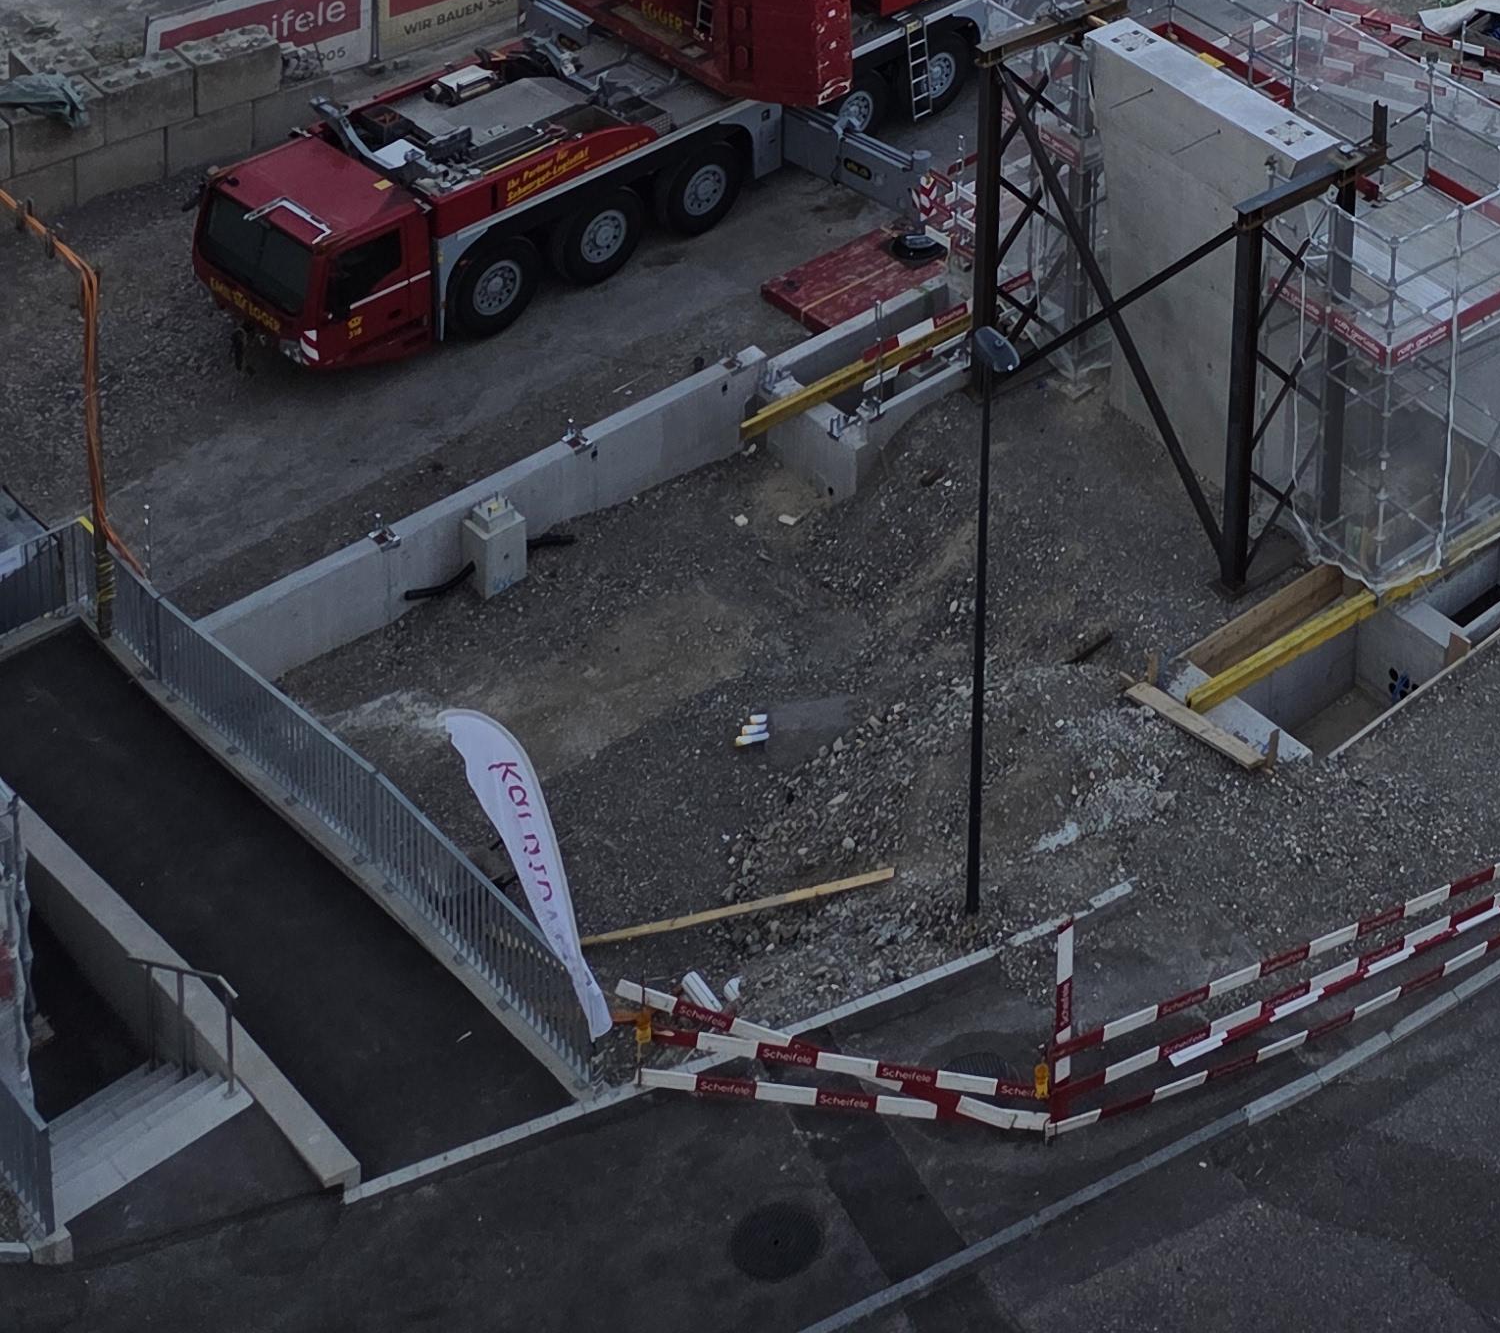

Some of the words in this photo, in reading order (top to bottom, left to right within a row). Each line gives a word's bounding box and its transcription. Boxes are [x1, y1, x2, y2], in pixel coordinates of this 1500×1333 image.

[271, 0, 346, 39] ifele
[404, 18, 432, 35] WIR
[437, 1, 483, 26] BAUEN
[641, 0, 683, 34] EGGER
[679, 1005, 728, 1029] Scheifele
[762, 1047, 812, 1066] Scheifele
[881, 1066, 932, 1084] Scheifele
[701, 1081, 752, 1096] Scheifele
[819, 1093, 870, 1110] Scheifele
